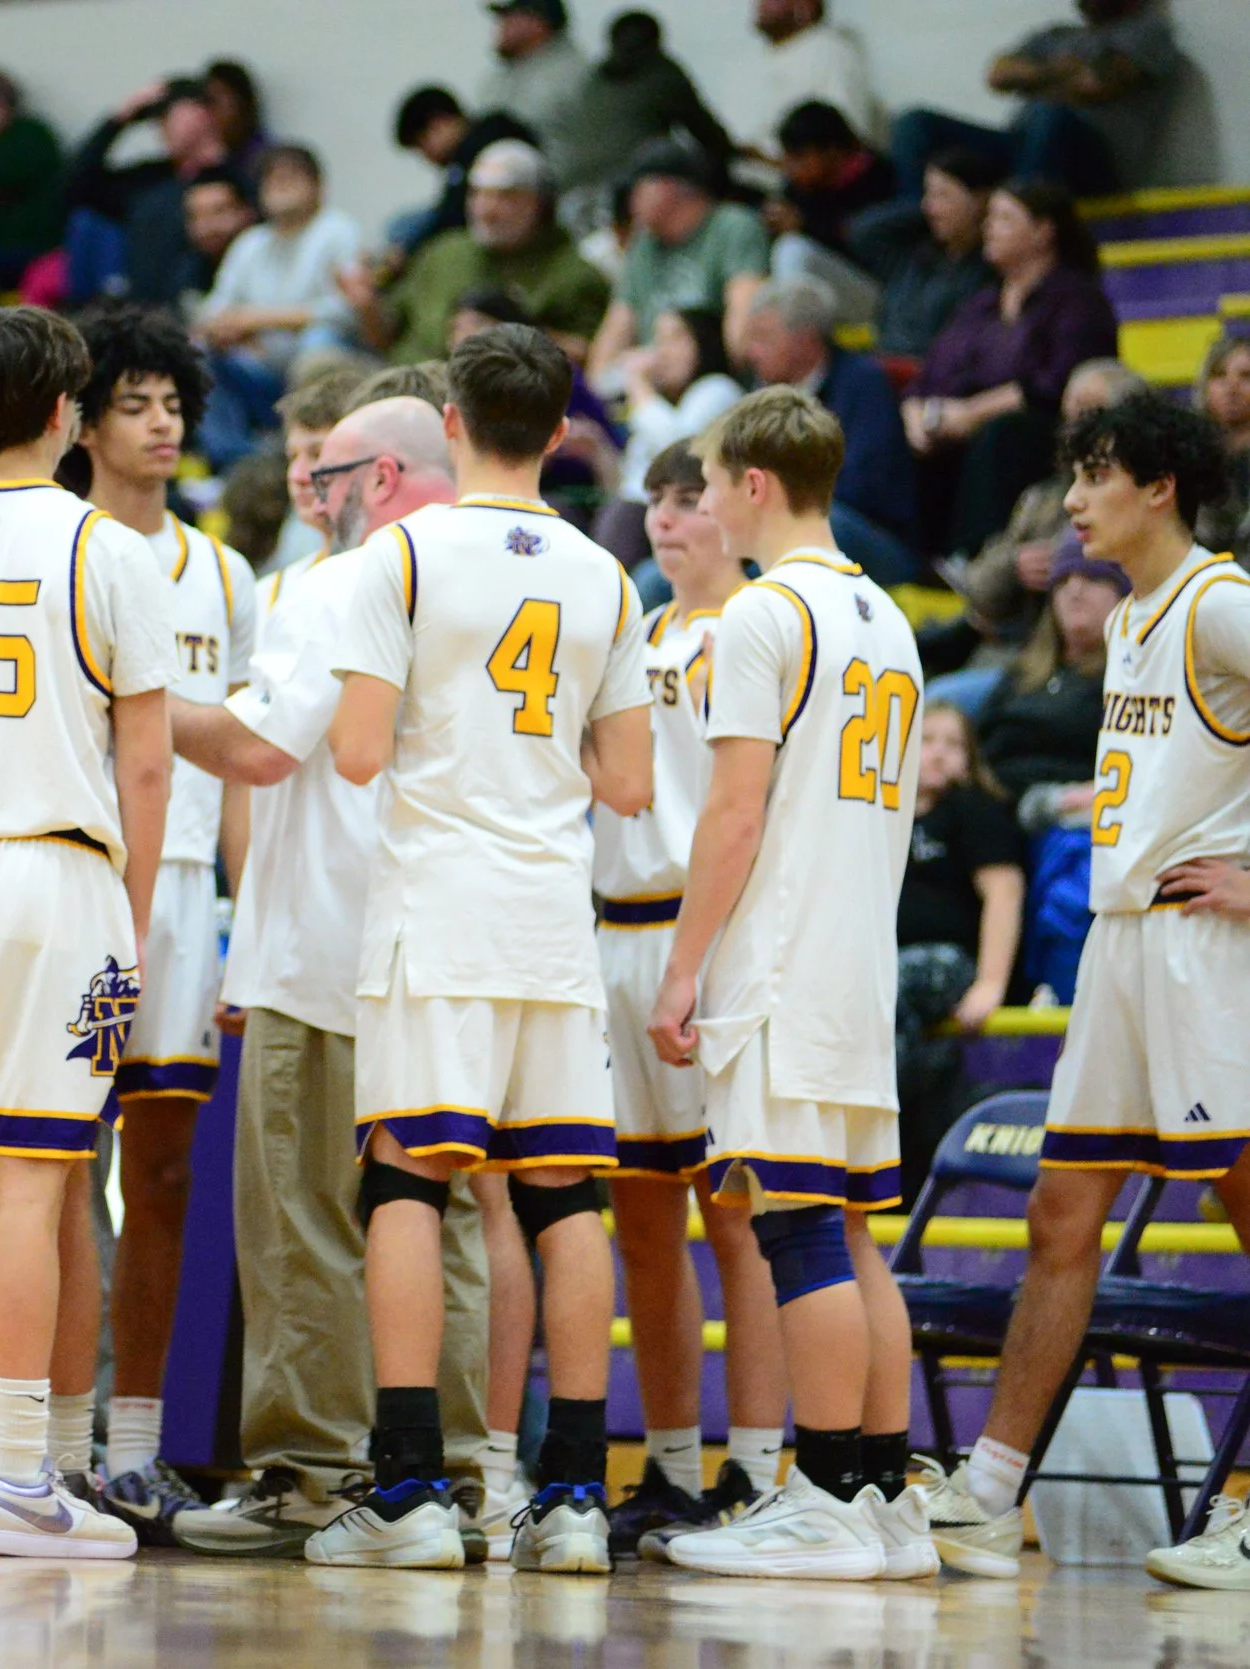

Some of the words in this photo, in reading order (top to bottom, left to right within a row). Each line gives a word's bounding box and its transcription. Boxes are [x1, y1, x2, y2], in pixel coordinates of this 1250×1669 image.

[175, 631, 220, 675] TS
[485, 597, 561, 738] 4
[838, 656, 920, 812] 20
